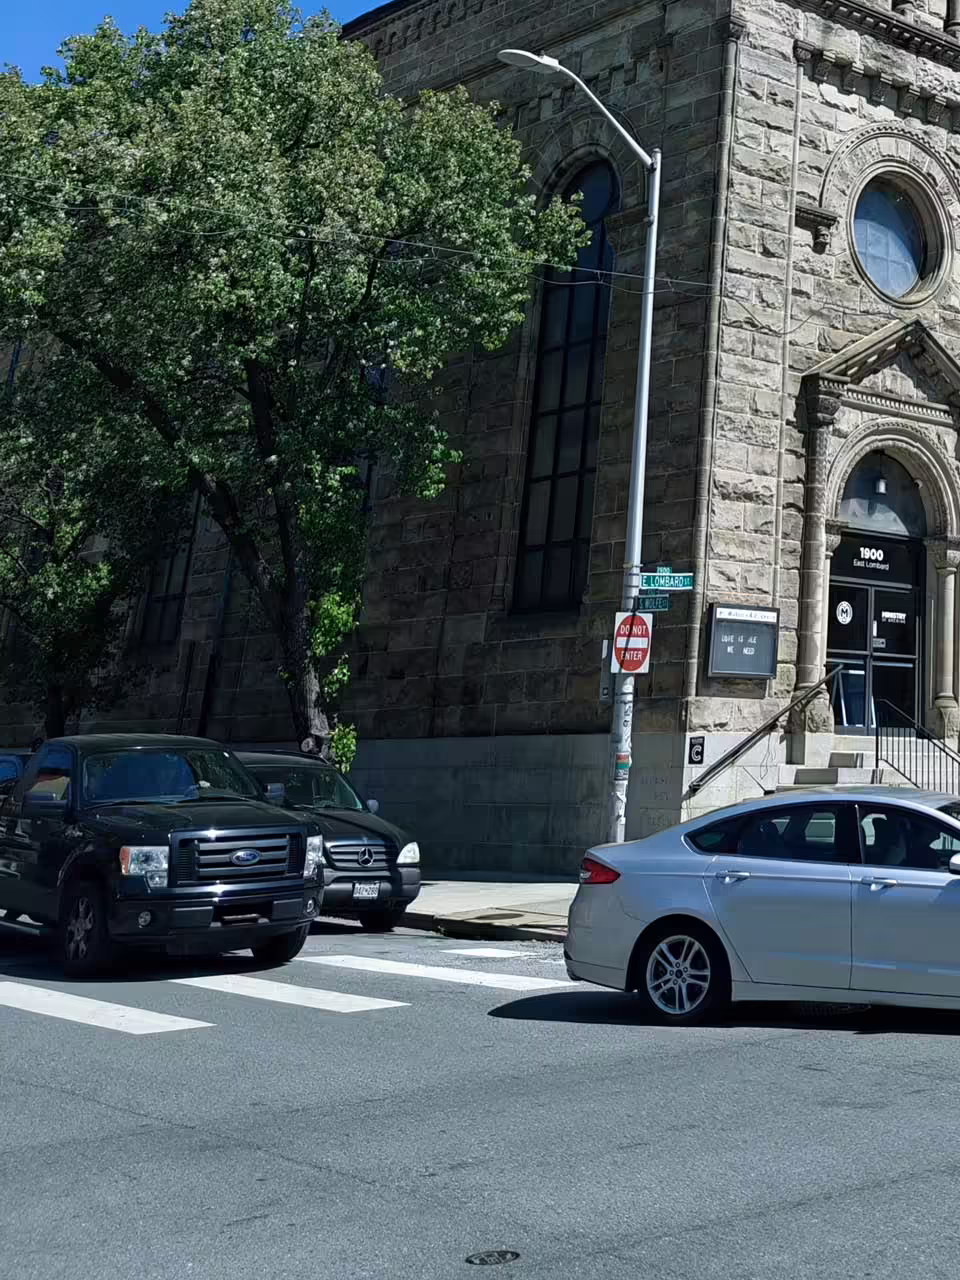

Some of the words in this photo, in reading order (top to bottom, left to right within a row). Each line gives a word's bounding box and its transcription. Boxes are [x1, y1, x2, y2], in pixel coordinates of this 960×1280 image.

[860, 547, 884, 561] 1900
[853, 558, 865, 567] East
[865, 560, 890, 571] Lombard
[642, 575, 649, 587] E
[650, 575, 684, 587] LOMBARD
[620, 624, 630, 635] DO
[632, 624, 647, 636] NOT
[620, 650, 643, 661] ENTER
